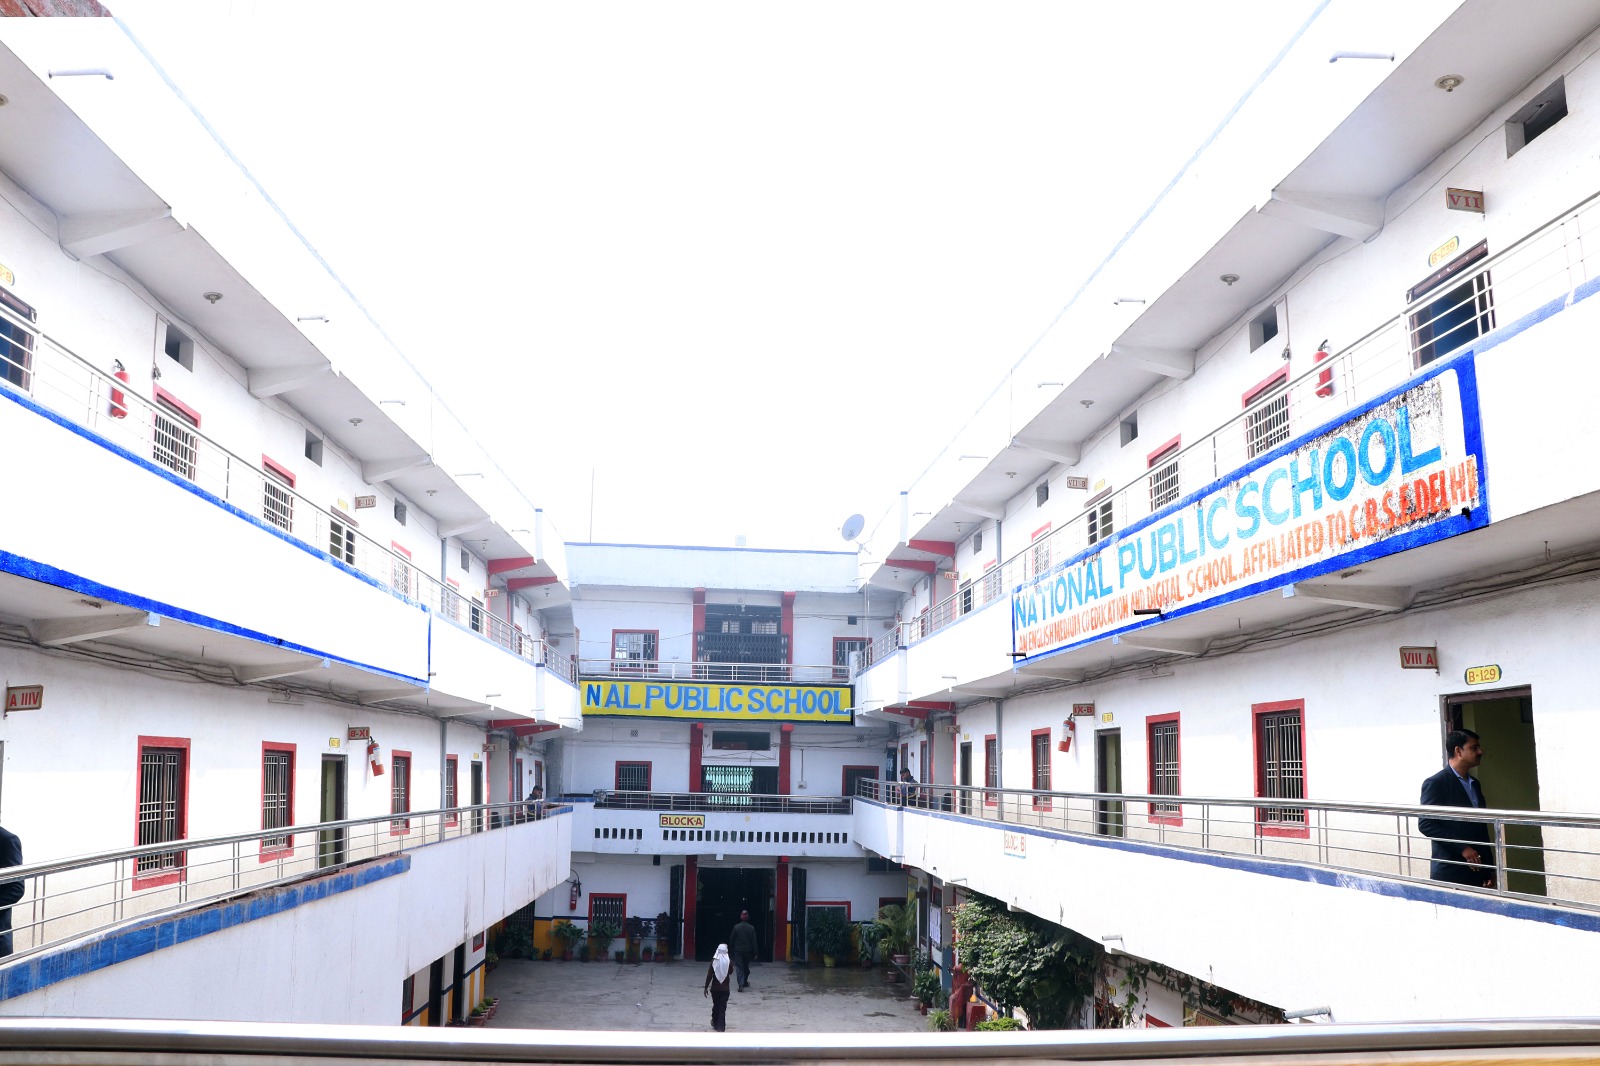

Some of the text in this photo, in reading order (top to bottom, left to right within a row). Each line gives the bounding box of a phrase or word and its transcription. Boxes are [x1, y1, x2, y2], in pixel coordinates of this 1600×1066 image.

[1450, 194, 1480, 208] VII
[1015, 405, 1442, 631] NATIONAL PUBLIC SCHOOL
[1146, 574, 1185, 608] DIGITAL
[1325, 510, 1347, 547] TO
[1403, 652, 1434, 664] VIII A
[1468, 668, 1496, 683] B-129
[586, 684, 850, 716] NAL PUBLIC SCHOOL
[1074, 706, 1093, 714] IX-B
